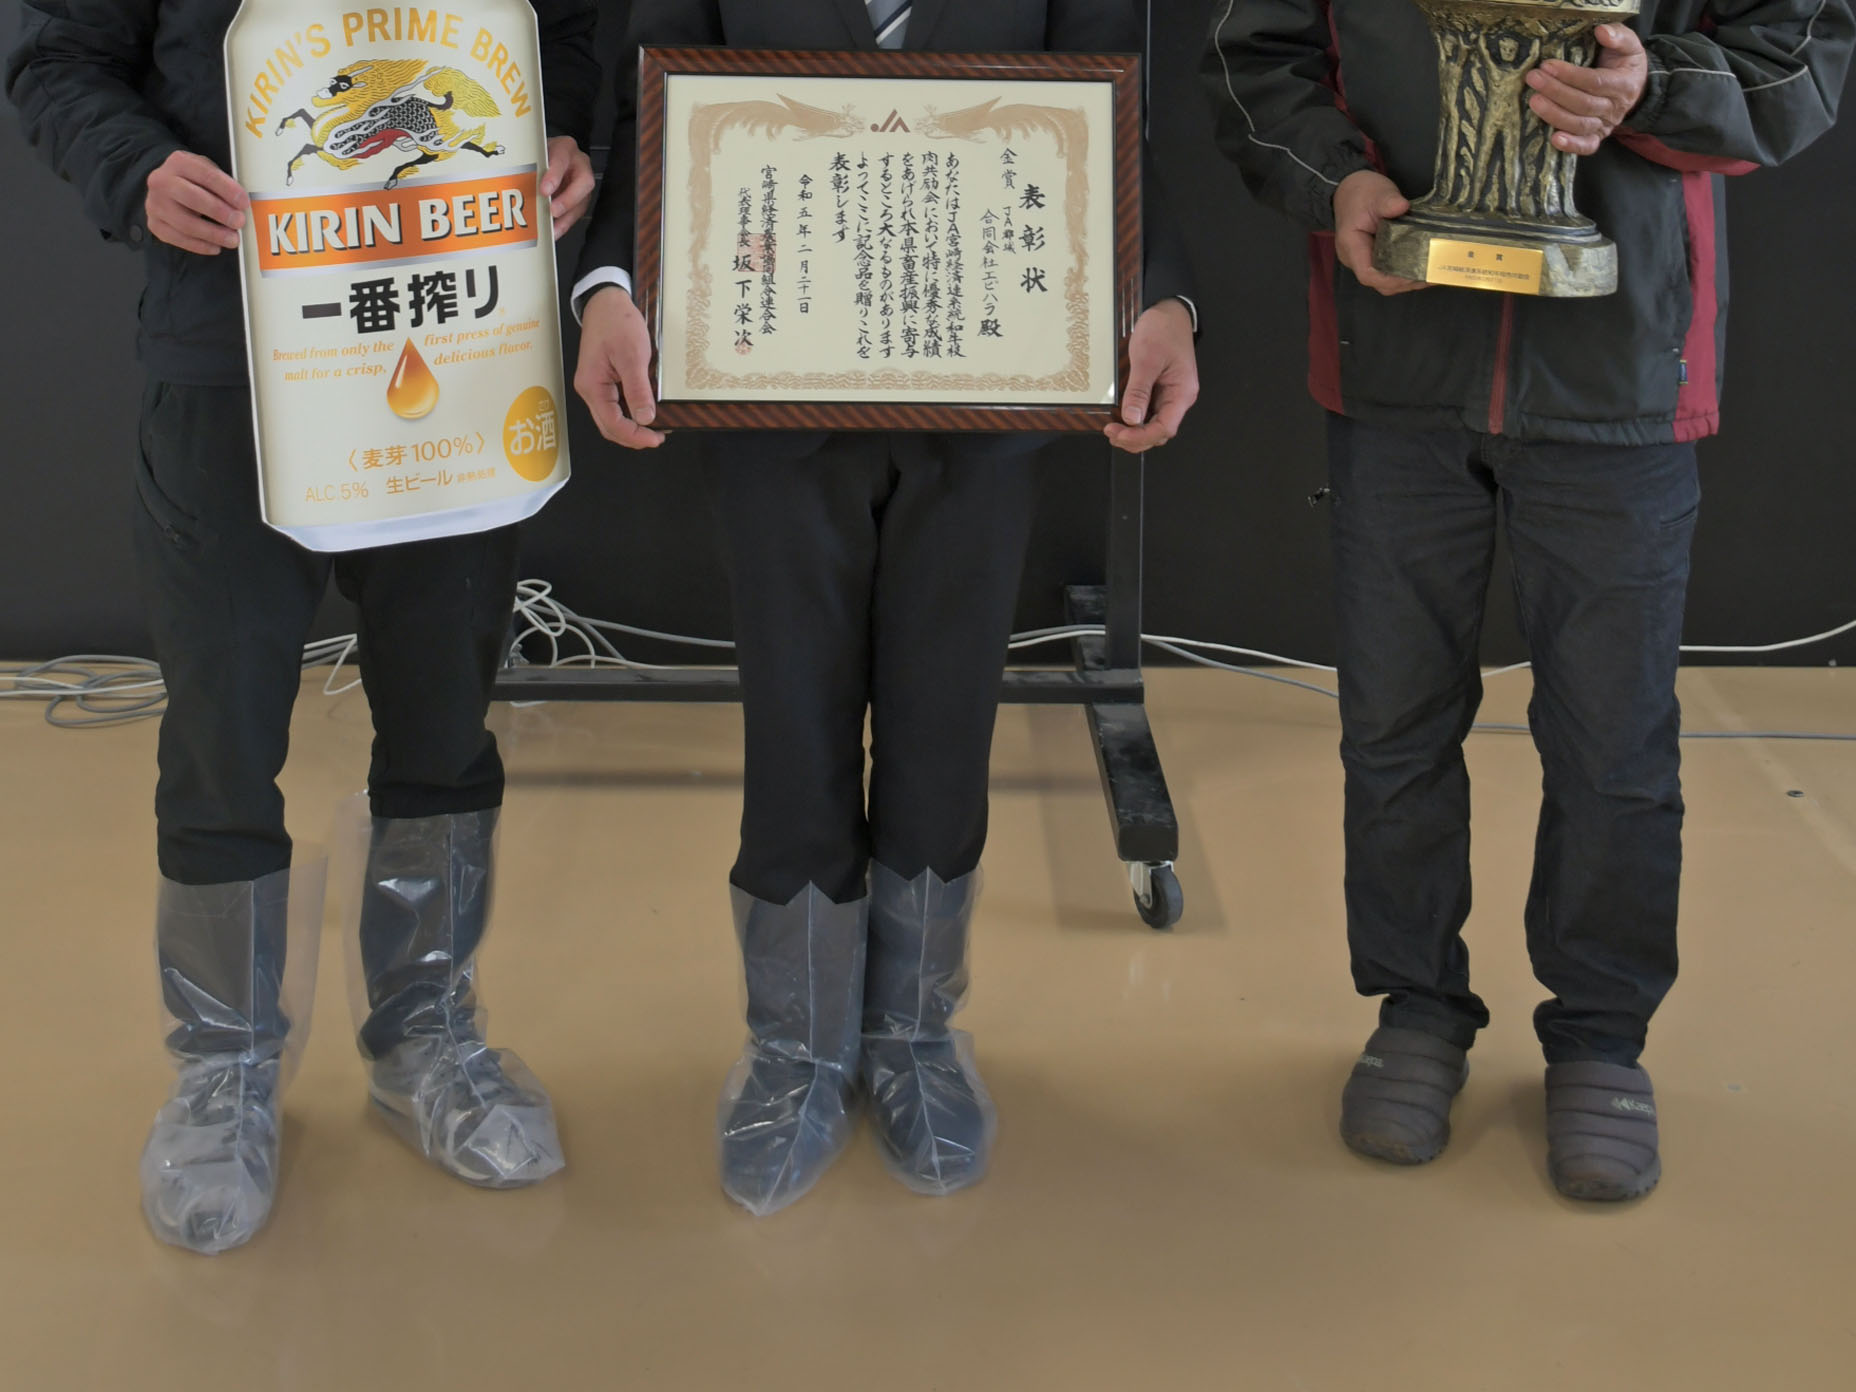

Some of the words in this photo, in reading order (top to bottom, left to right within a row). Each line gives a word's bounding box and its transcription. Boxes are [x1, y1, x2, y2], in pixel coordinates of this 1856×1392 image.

[245, 23, 332, 139] KIRIN'S
[342, 7, 464, 49] PRIME
[469, 27, 532, 118] BREW
[828, 151, 851, 243] 表彰します
[1000, 148, 1018, 189] 金賞
[267, 203, 403, 256] KIRIN
[418, 188, 528, 241] BEER
[796, 174, 813, 314] 令和五年二月二十一日
[1018, 184, 1048, 293] 表彰状
[301, 265, 501, 335] 一番搾り
[732, 253, 757, 347] 坂下栄次
[978, 209, 1003, 338] 合同会社エビハラ殿
[310, 346, 337, 358] from
[341, 343, 370, 358] only
[373, 340, 394, 353] the
[424, 333, 452, 346] first
[456, 328, 489, 345] press
[505, 319, 540, 337] genuine
[434, 347, 495, 365] delicious
[311, 365, 332, 379] for
[334, 368, 342, 377] a
[509, 411, 557, 456] お酒
[386, 469, 453, 495] 生ビール
